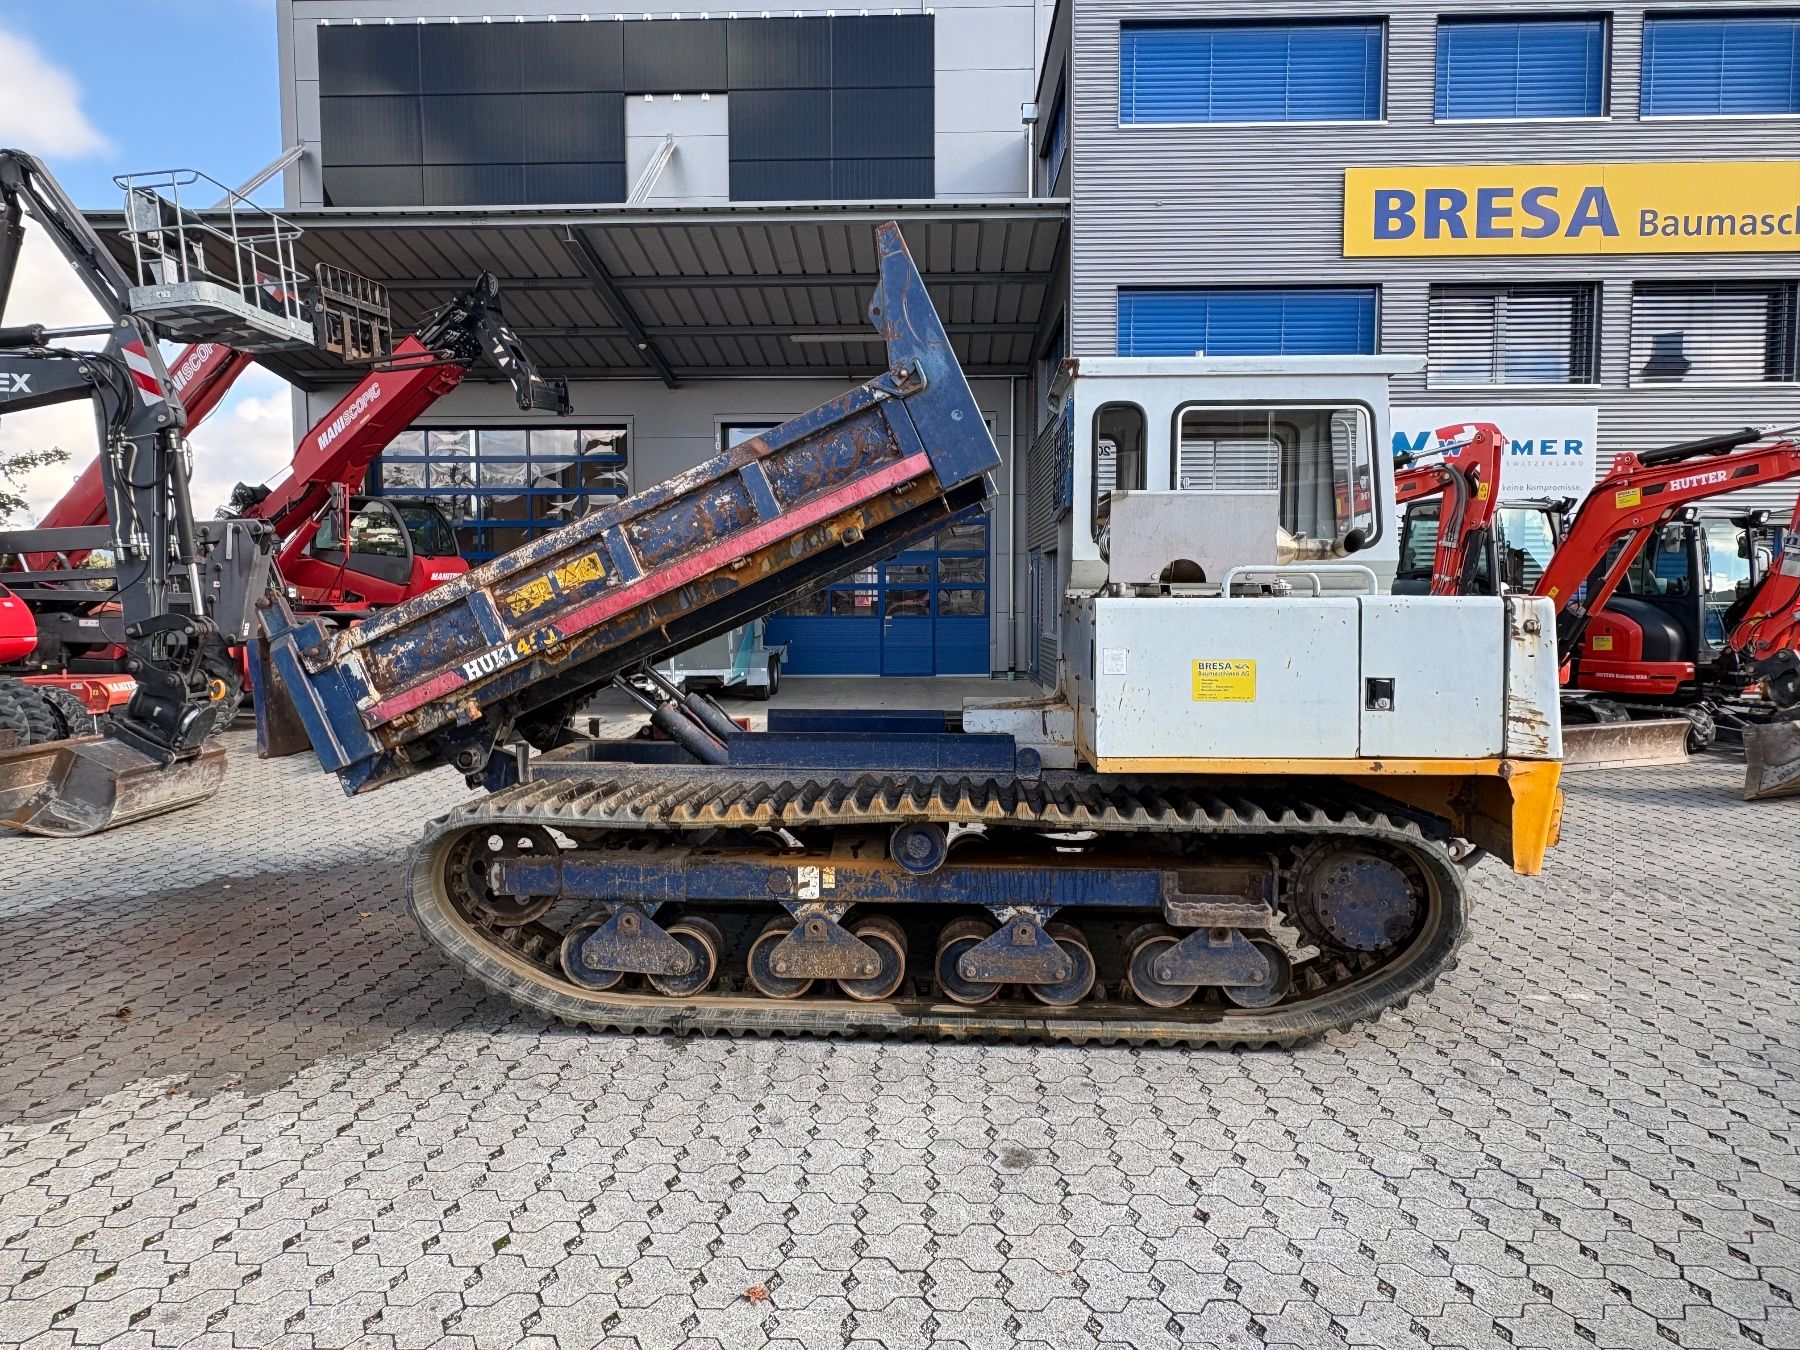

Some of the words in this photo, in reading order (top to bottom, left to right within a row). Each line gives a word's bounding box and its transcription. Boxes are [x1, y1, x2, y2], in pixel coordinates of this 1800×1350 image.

[1373, 186, 1620, 240] BRESA
[317, 382, 381, 451] MANISCOPIC
[1669, 470, 1728, 491] HUTTER
[462, 643, 518, 681] HUKI
[1198, 662, 1232, 670] BRESA
